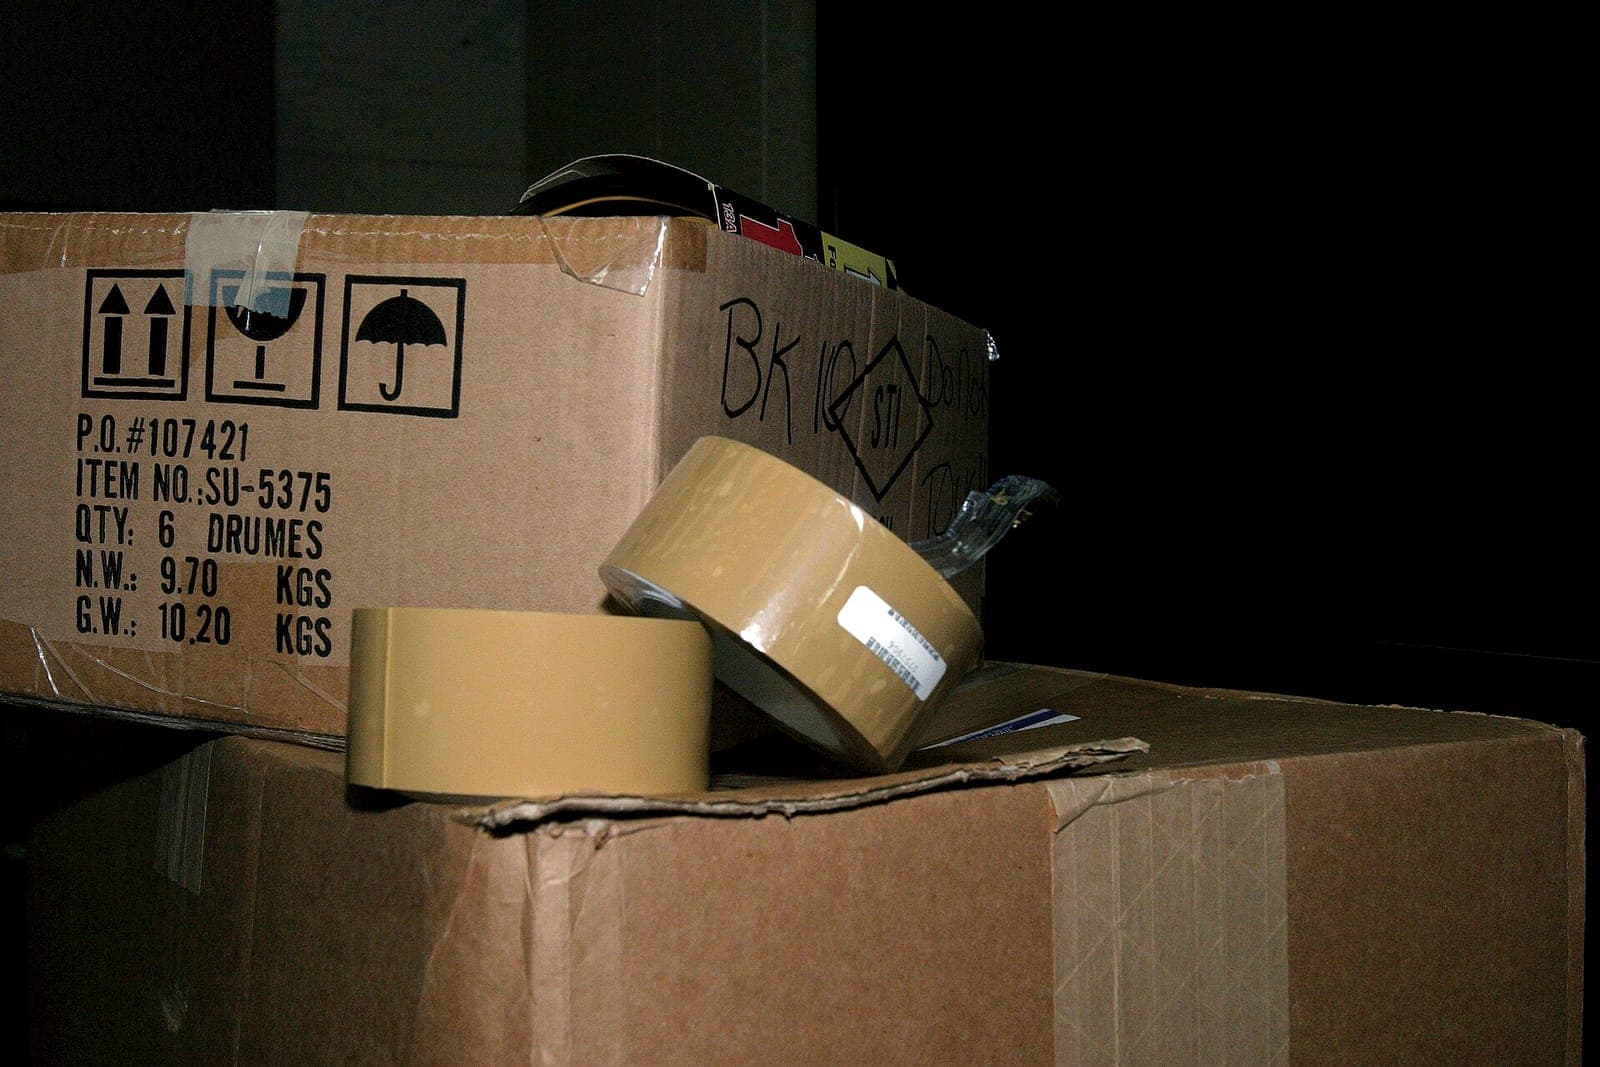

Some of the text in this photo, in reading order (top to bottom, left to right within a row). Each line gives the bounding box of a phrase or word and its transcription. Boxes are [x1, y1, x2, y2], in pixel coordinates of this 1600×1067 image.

[720, 297, 801, 445] BK
[871, 384, 902, 450] STI
[76, 458, 139, 500] ITEM
[75, 503, 323, 560] QTY: 6 DRUMES
[76, 549, 332, 609] N.W.: 9.70 KGS
[76, 595, 137, 637] G.W.:
[275, 613, 332, 658] KGS
